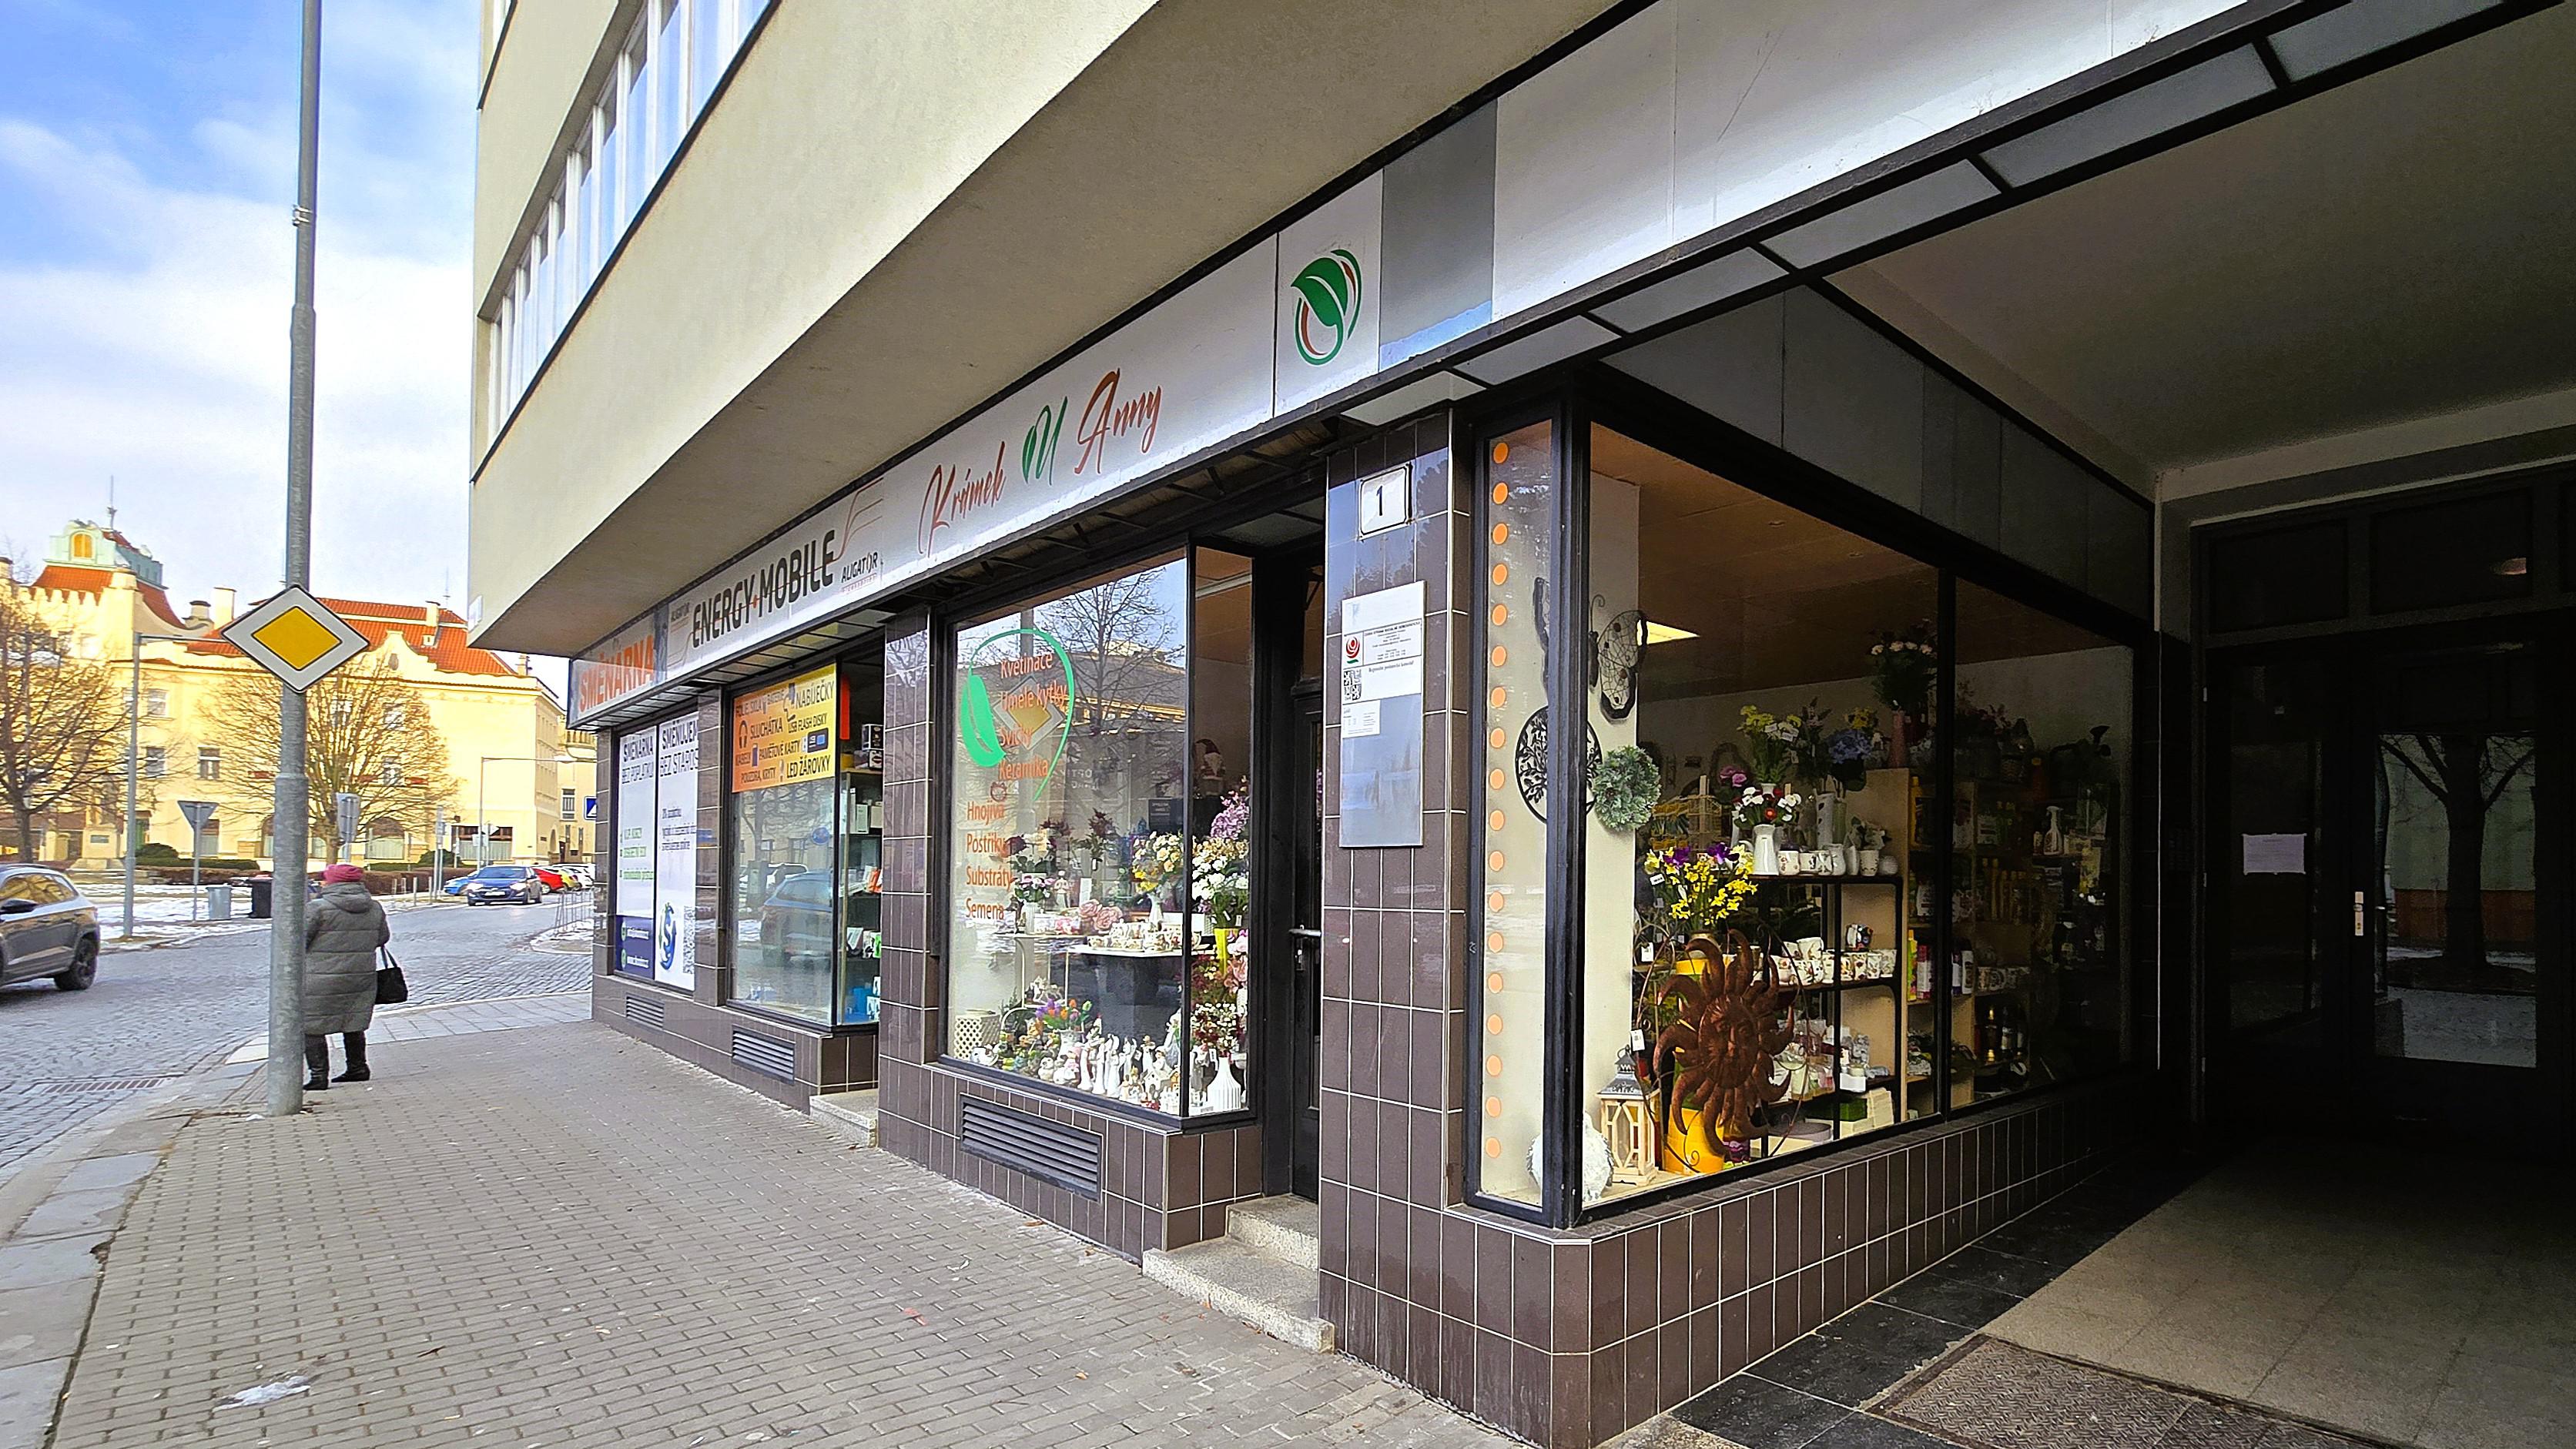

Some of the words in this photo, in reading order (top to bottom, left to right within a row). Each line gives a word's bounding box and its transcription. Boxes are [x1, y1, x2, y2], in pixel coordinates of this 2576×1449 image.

[1074, 368, 1161, 474] Anny
[1375, 485, 1383, 517] 1
[693, 574, 755, 648] ENERGY
[759, 530, 835, 617] MOBILE
[750, 717, 783, 739] SLUCHÁTKA
[813, 713, 827, 728] DISKY
[787, 761, 798, 778] LED
[799, 755, 831, 777] ŽÁROVKY
[998, 754, 1049, 781] Keramika
[966, 799, 1004, 825] Hnojiva
[966, 865, 1013, 892] Substráty
[966, 898, 1005, 920] Semena
